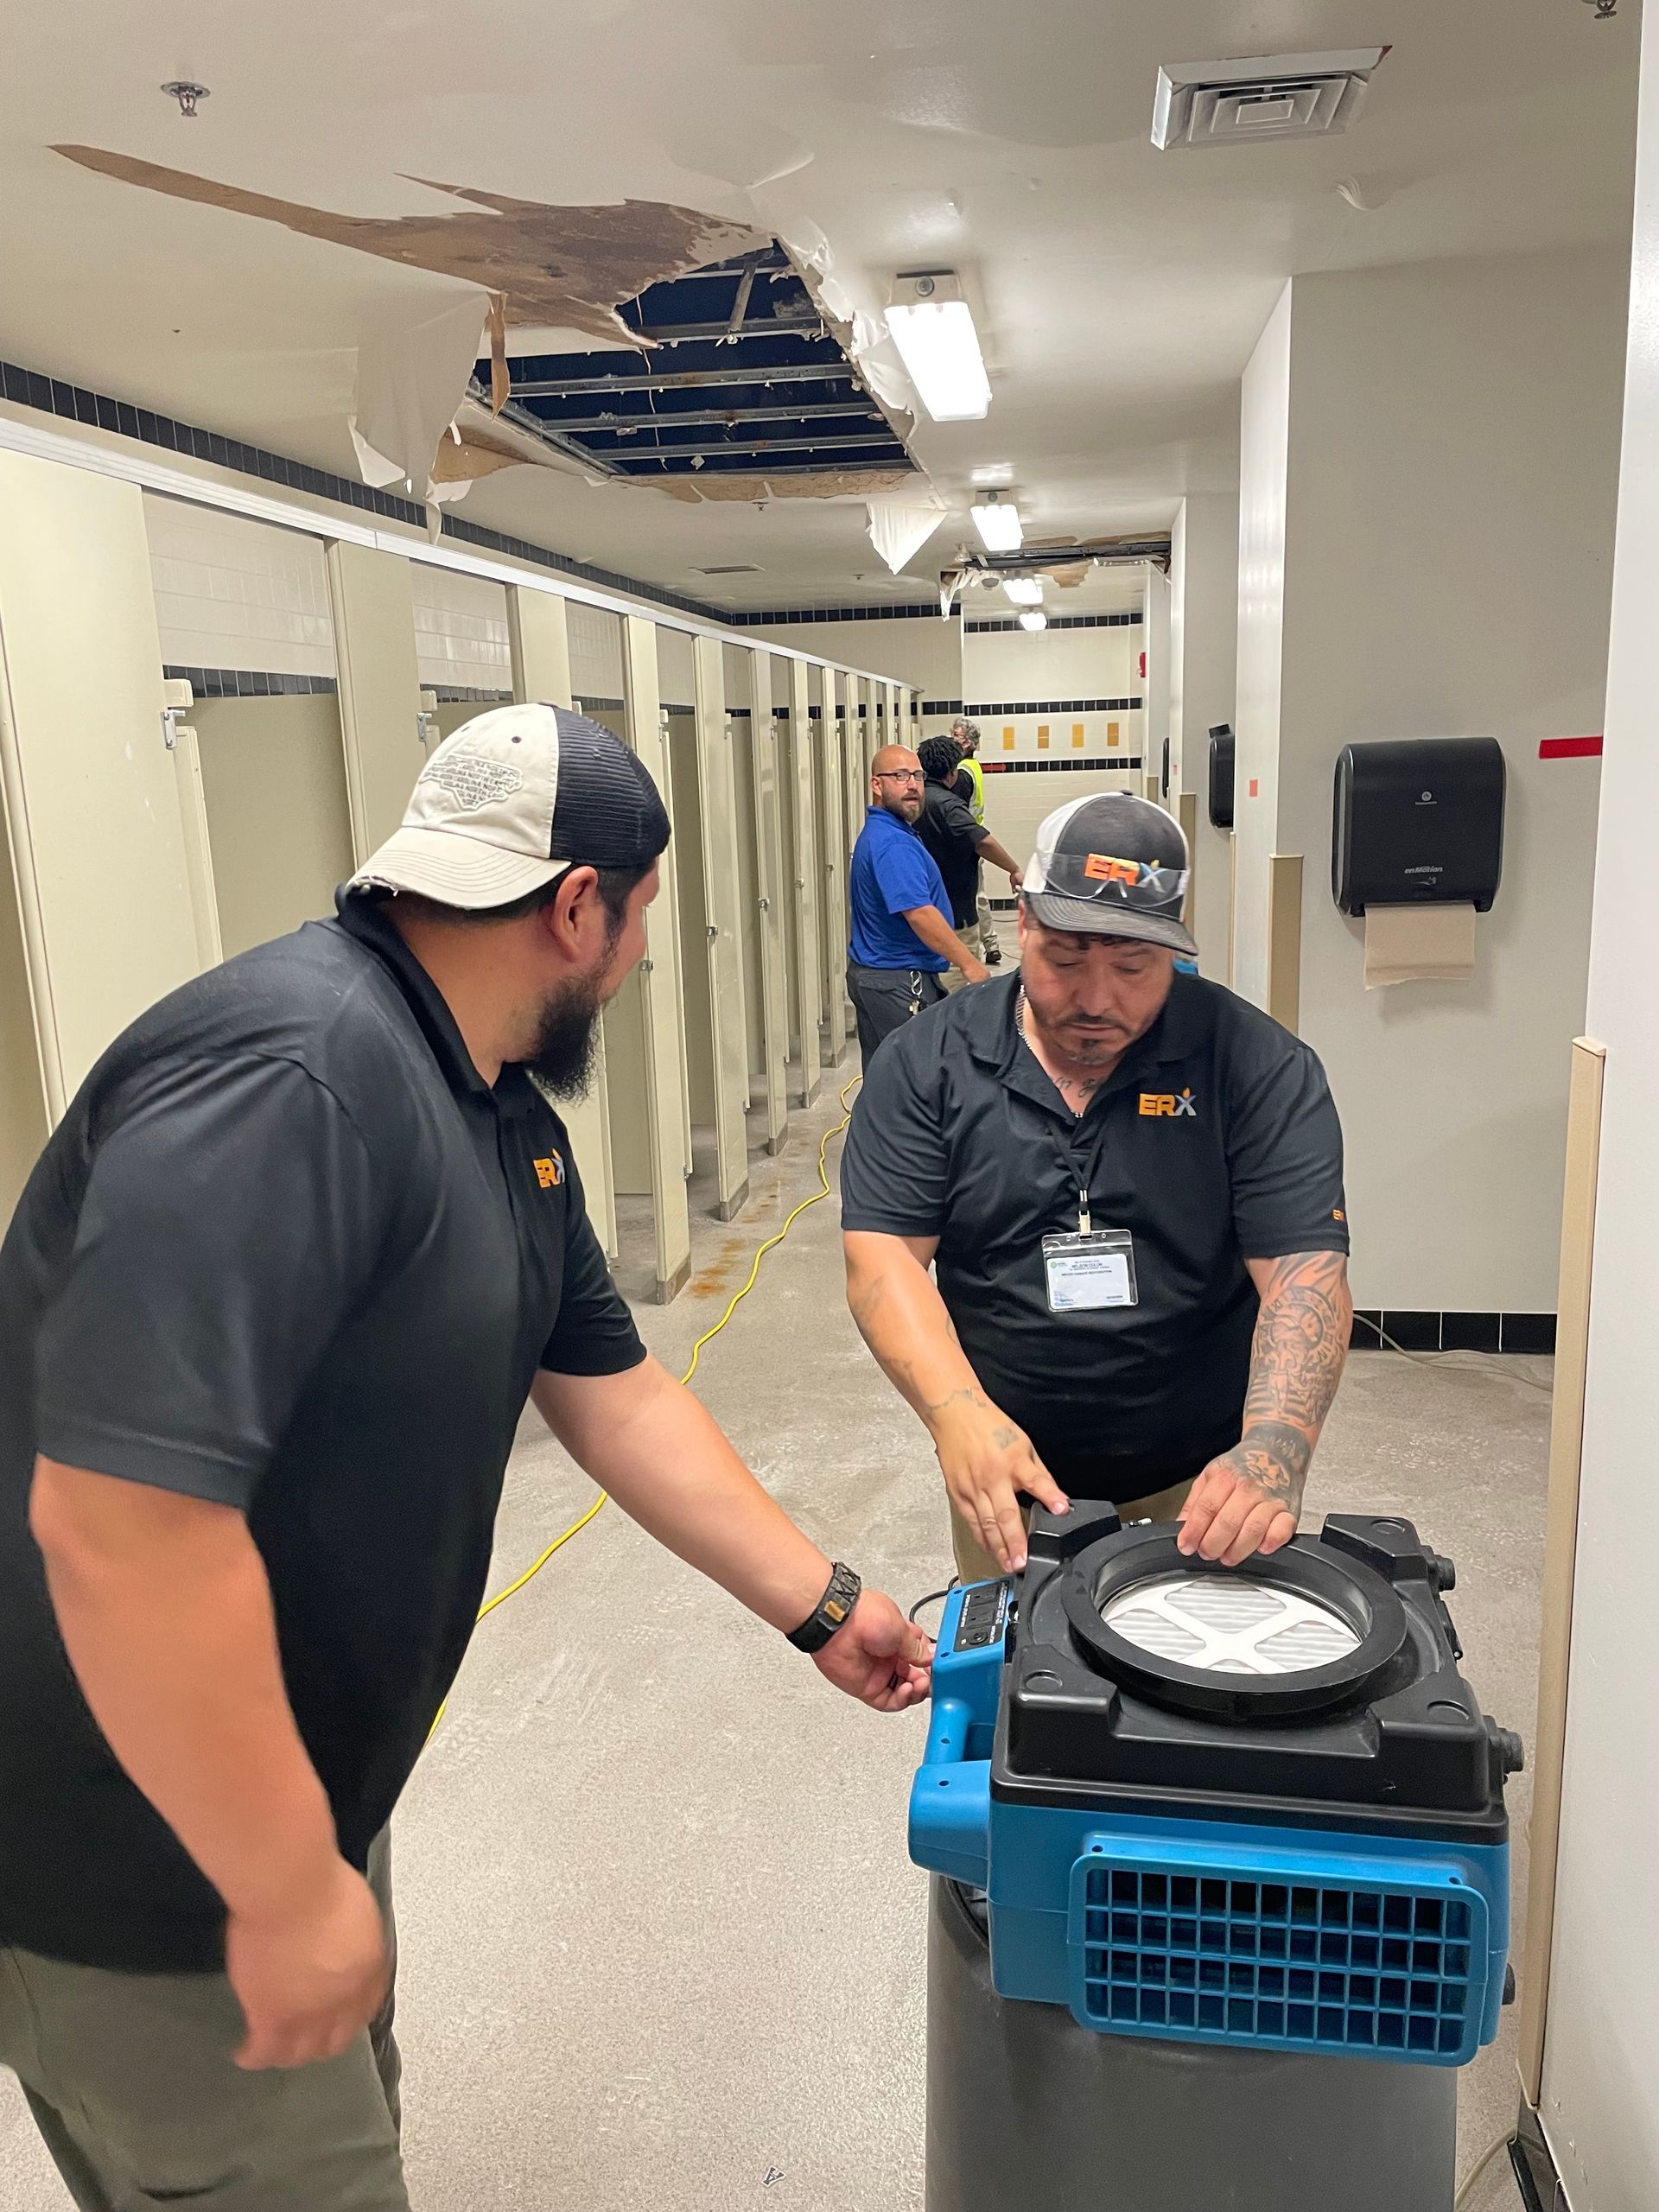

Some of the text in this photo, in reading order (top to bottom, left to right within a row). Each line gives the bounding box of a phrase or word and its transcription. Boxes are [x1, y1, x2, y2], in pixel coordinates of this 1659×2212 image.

[1084, 853, 1166, 893] ERX
[1404, 865, 1443, 874] enMotion
[1139, 1087, 1197, 1116] ERX
